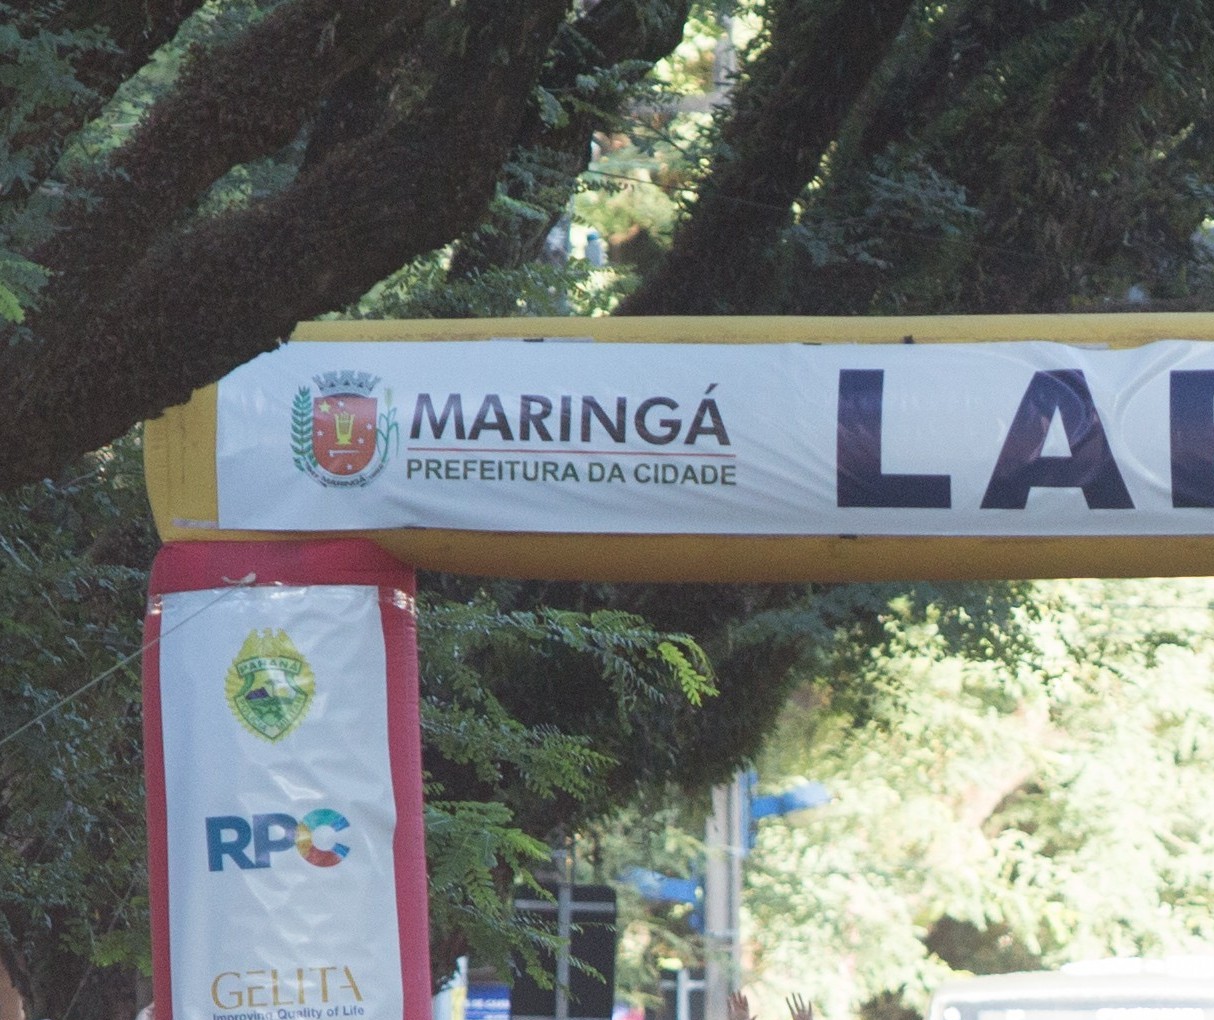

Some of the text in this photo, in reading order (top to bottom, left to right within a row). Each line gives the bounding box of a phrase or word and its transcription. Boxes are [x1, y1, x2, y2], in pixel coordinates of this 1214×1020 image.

[409, 382, 732, 447] MARINGÁ
[406, 458, 580, 483] PREFEITURA
[587, 461, 625, 484] DA
[633, 462, 737, 487] CIDADE
[205, 808, 350, 872] RPC
[210, 965, 364, 1010] GELITA
[277, 1007, 323, 1020] Quality
[327, 1006, 339, 1017] of
[342, 1005, 365, 1016] Life
